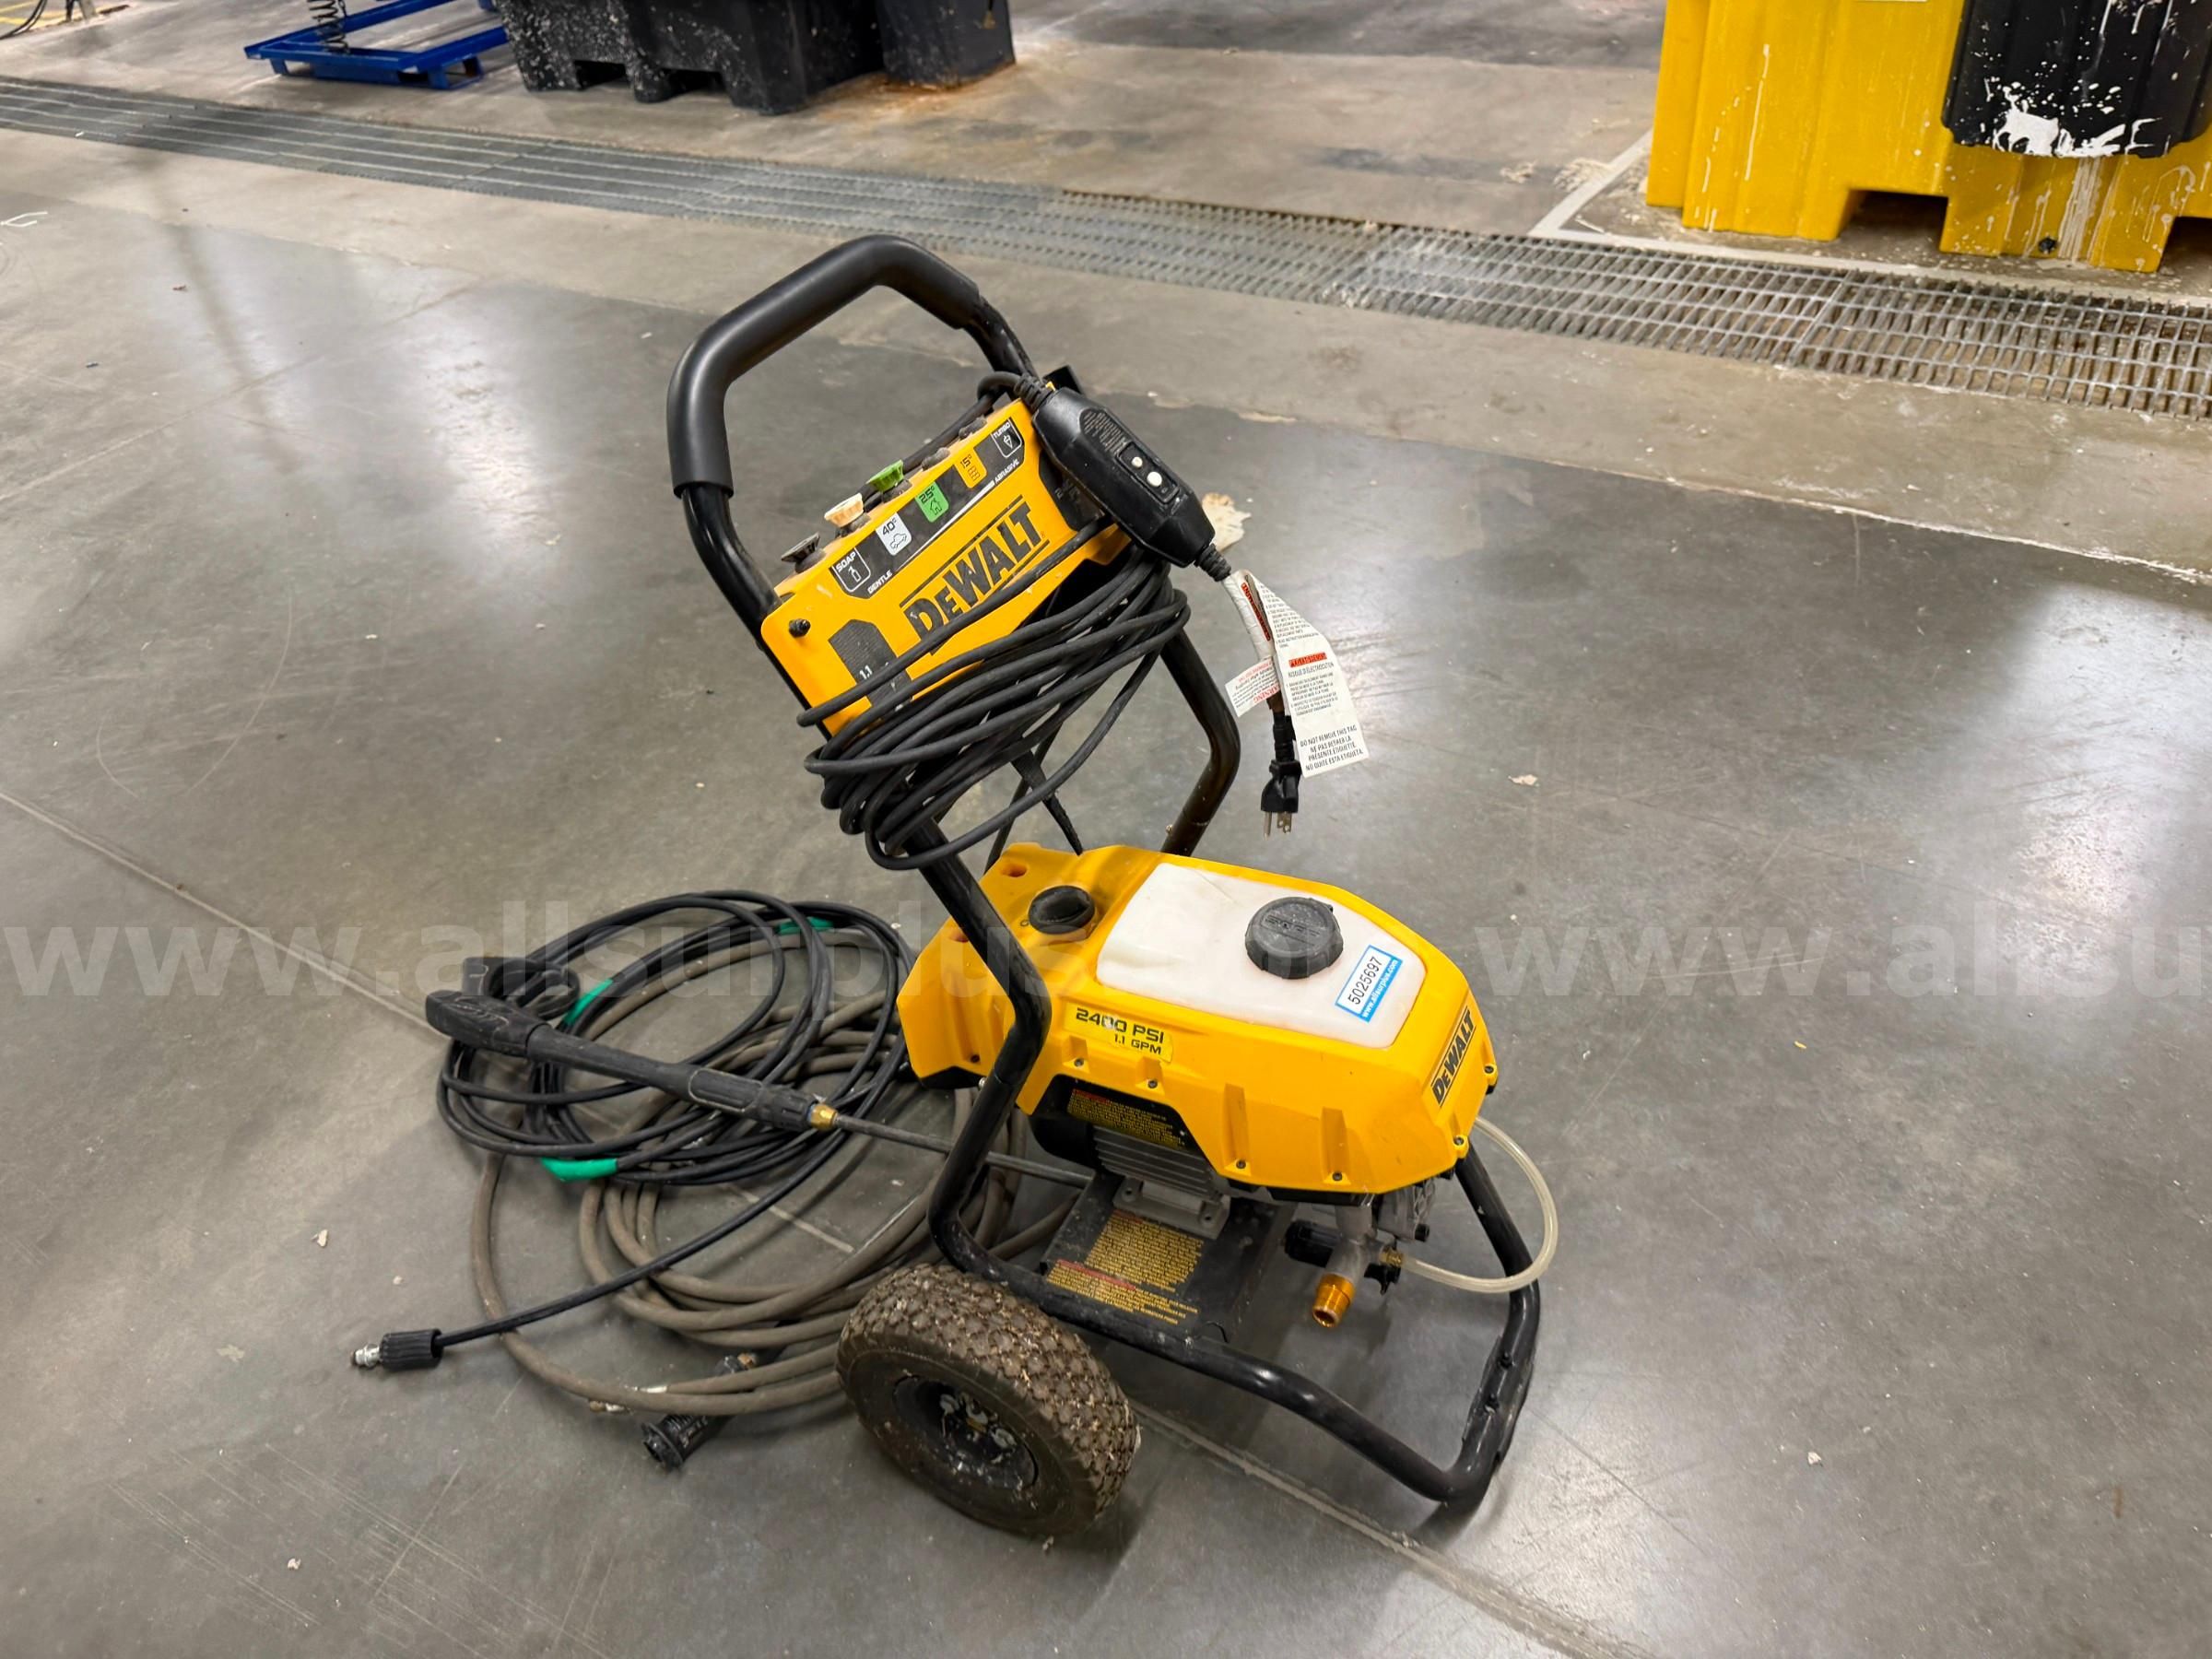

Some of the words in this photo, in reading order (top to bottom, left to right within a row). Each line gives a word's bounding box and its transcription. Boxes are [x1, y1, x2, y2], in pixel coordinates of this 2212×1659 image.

[994, 458, 1019, 485] ABRASIVE
[835, 551, 856, 572] SOAP
[903, 501, 1042, 645] DEWALT
[867, 570, 893, 594] GENTLE
[1308, 735, 1318, 746] NOT
[1318, 732, 1336, 743] REMOVE
[1336, 728, 1347, 736] THIS
[1347, 724, 1358, 734] TAG
[1347, 956, 1382, 1005] 5025697
[1362, 959, 1399, 1018] www.allsurplus.com
[1114, 1034, 1125, 1044] 1.1
[1131, 1039, 1161, 1055] GPM
[1133, 1024, 1164, 1043] PSI
[1431, 1009, 1475, 1105] DEWALT
